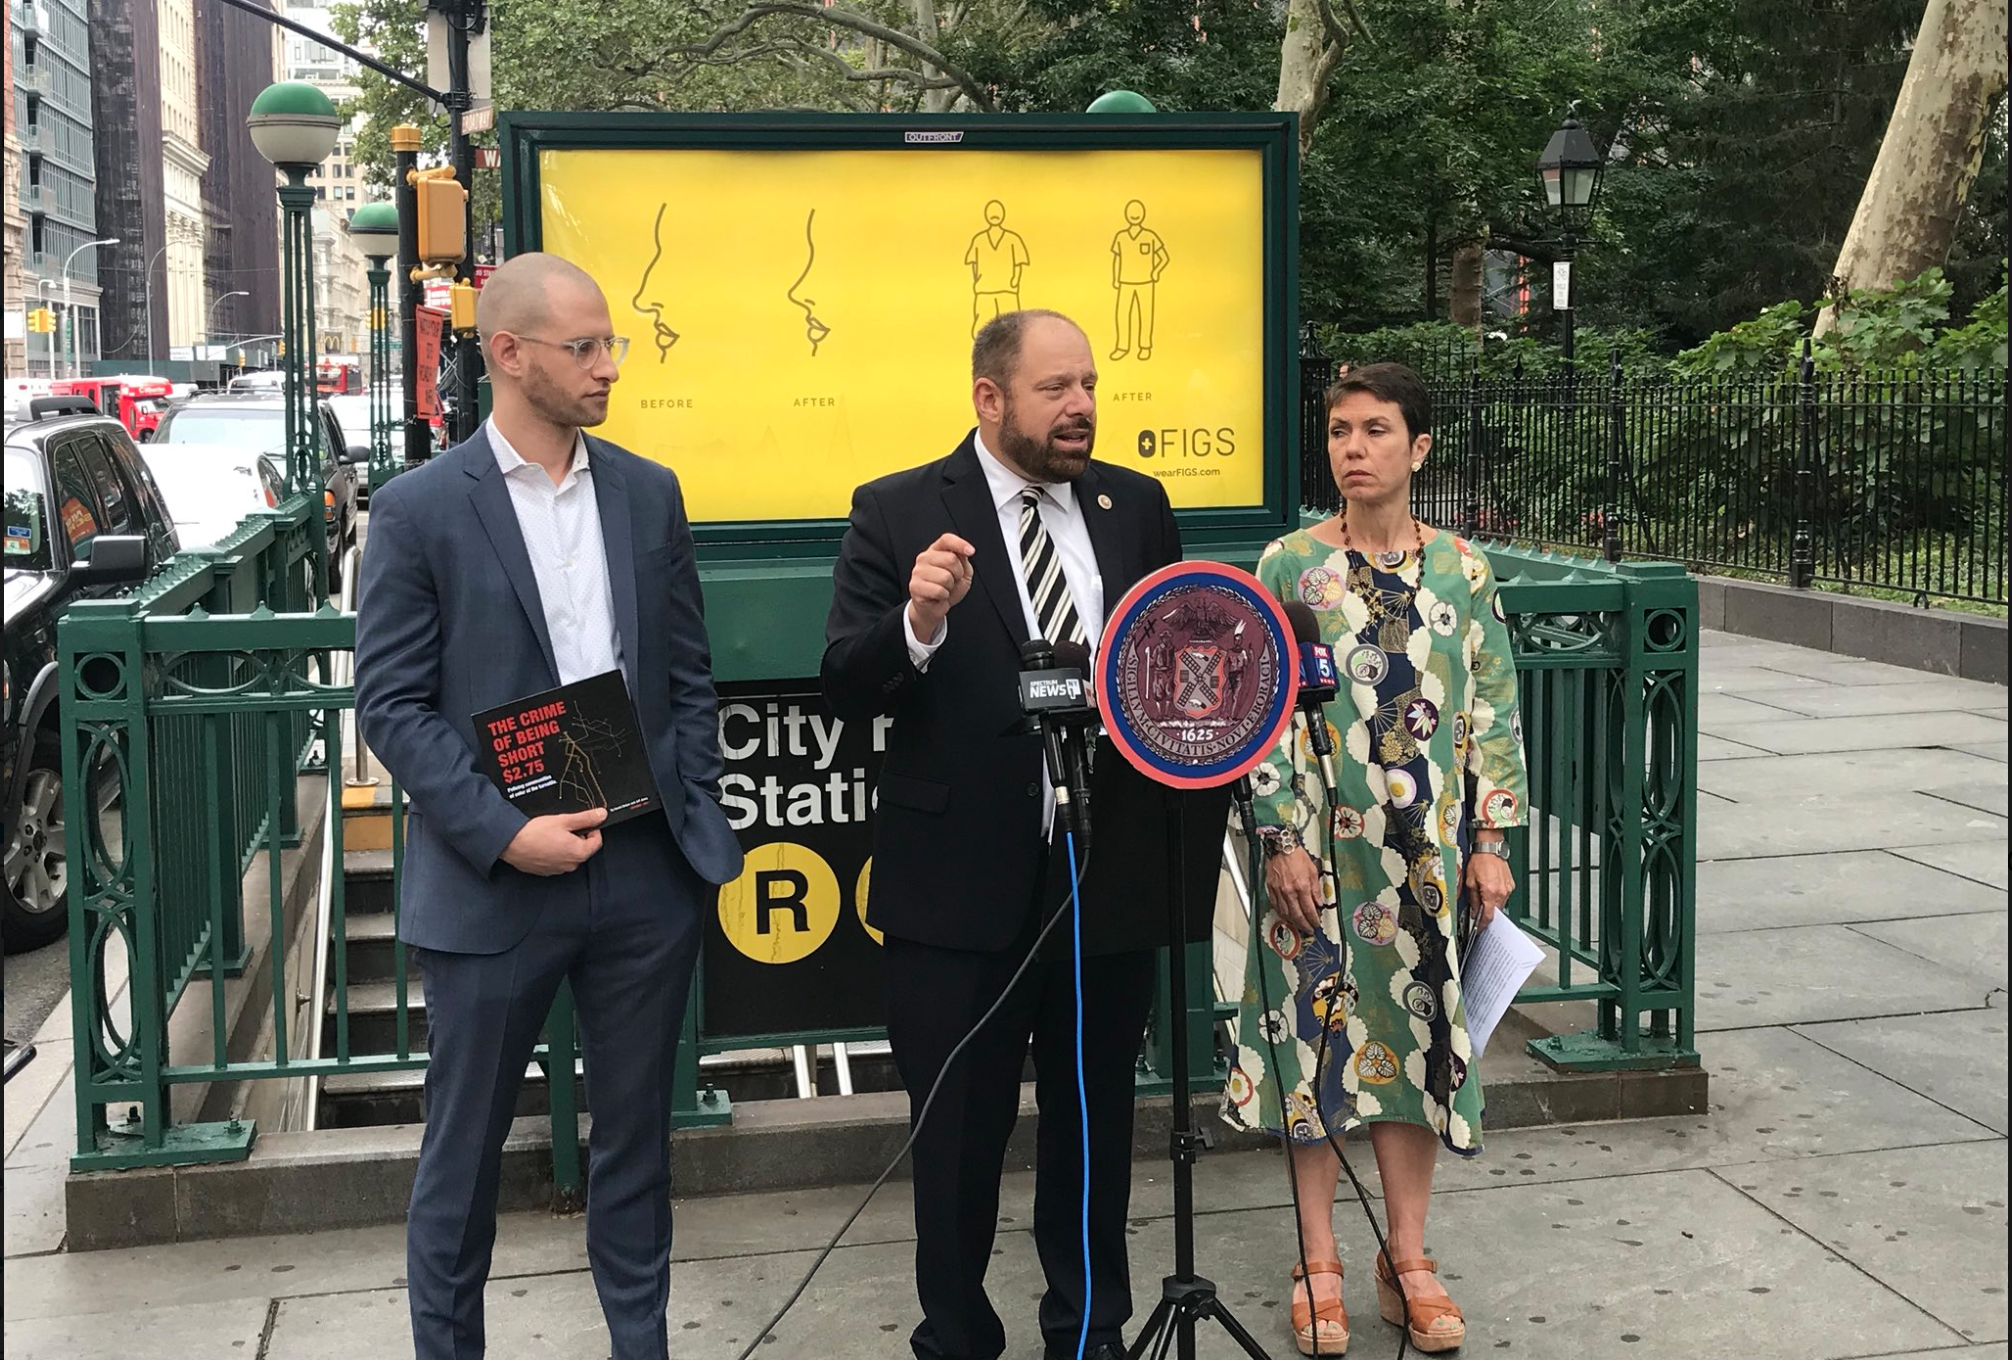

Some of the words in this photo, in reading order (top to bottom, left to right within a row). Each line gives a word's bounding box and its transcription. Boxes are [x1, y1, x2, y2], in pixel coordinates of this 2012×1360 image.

[908, 133, 961, 141] OUTFRONT
[640, 399, 693, 409] BEFORE
[793, 397, 835, 407] AFTER
[1113, 392, 1152, 401] AFTER
[1160, 427, 1235, 458] FIGS
[1153, 468, 1220, 478] wearFIGS.com
[1314, 646, 1328, 658] FOX
[1319, 658, 1331, 678] 5
[1030, 684, 1067, 698] NEWS
[487, 716, 517, 736] THE
[519, 701, 567, 727] CRIME
[492, 735, 513, 752] OF
[515, 720, 561, 746] BEING
[717, 702, 845, 770] City
[1181, 728, 1214, 742] 1625
[1217, 724, 1248, 751] NOVI
[497, 741, 545, 768] SHORT
[503, 760, 545, 784] $2.75
[717, 767, 878, 830] Stati
[755, 869, 811, 935] R
